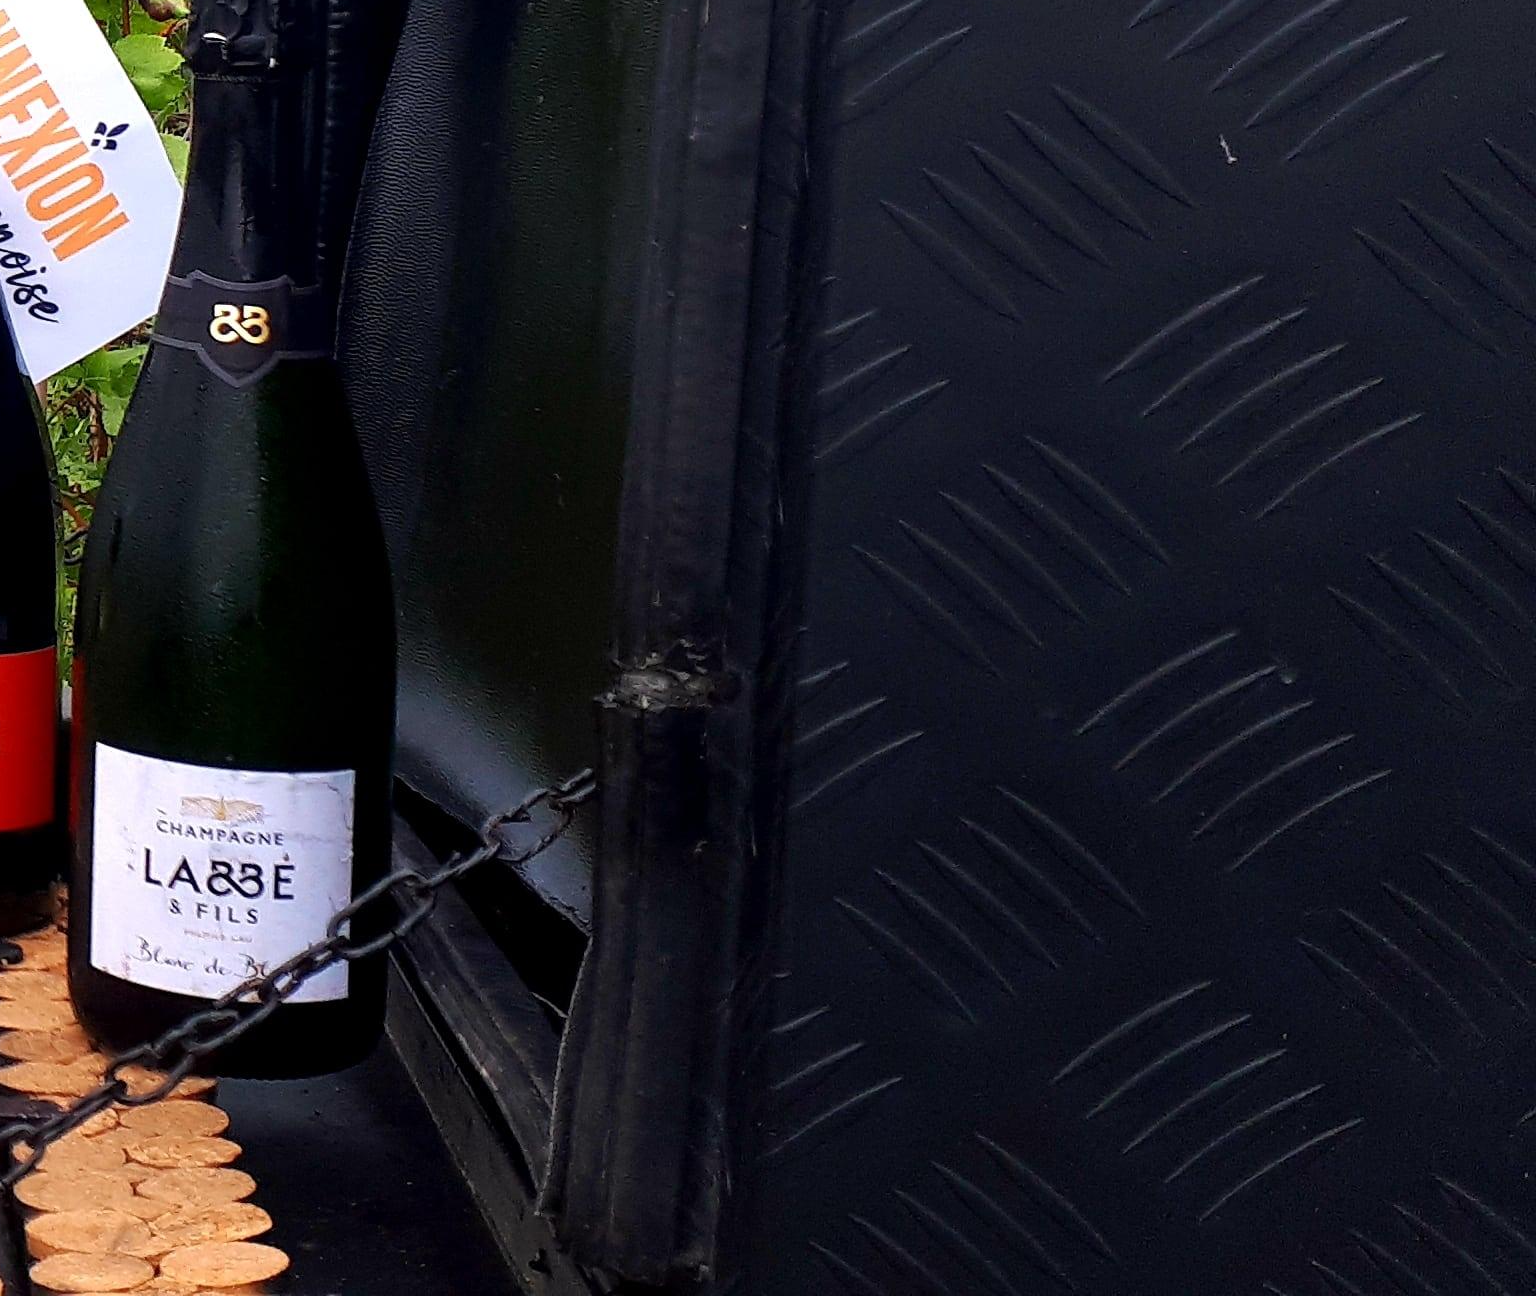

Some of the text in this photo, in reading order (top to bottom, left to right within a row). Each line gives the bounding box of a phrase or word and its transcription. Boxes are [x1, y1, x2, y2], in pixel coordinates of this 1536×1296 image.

[156, 819, 285, 846] CHAMPAGNE
[169, 898, 258, 924] & FILS
